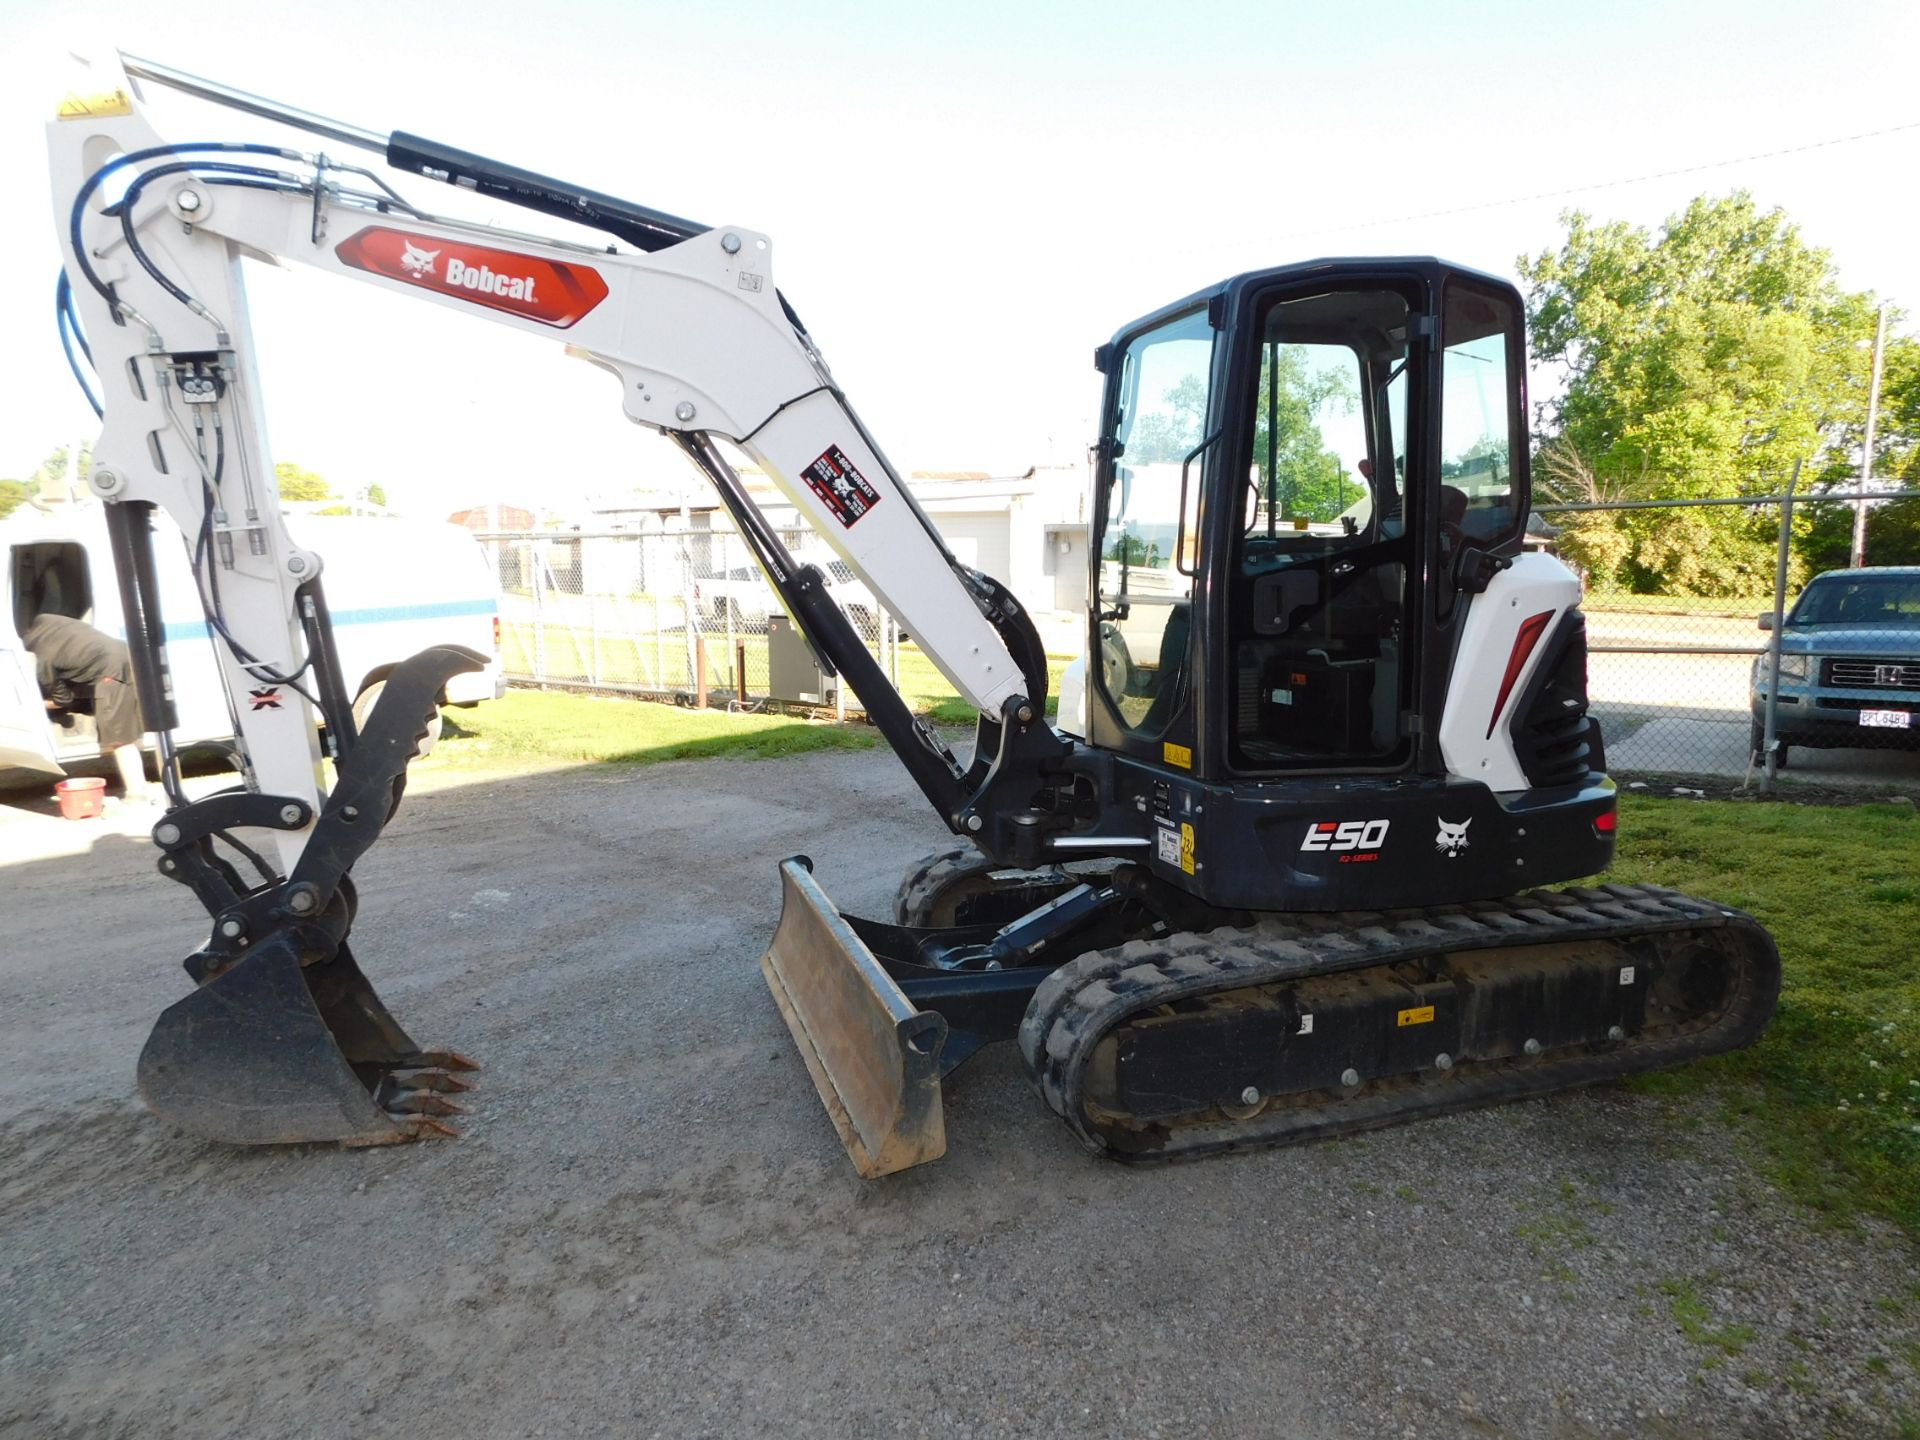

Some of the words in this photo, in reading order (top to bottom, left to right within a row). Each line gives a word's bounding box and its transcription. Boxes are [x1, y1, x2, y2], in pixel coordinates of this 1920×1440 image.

[446, 258, 535, 302] Bobcat
[833, 451, 875, 497] 1-800-BOBCATS
[1300, 819, 1390, 851] E50
